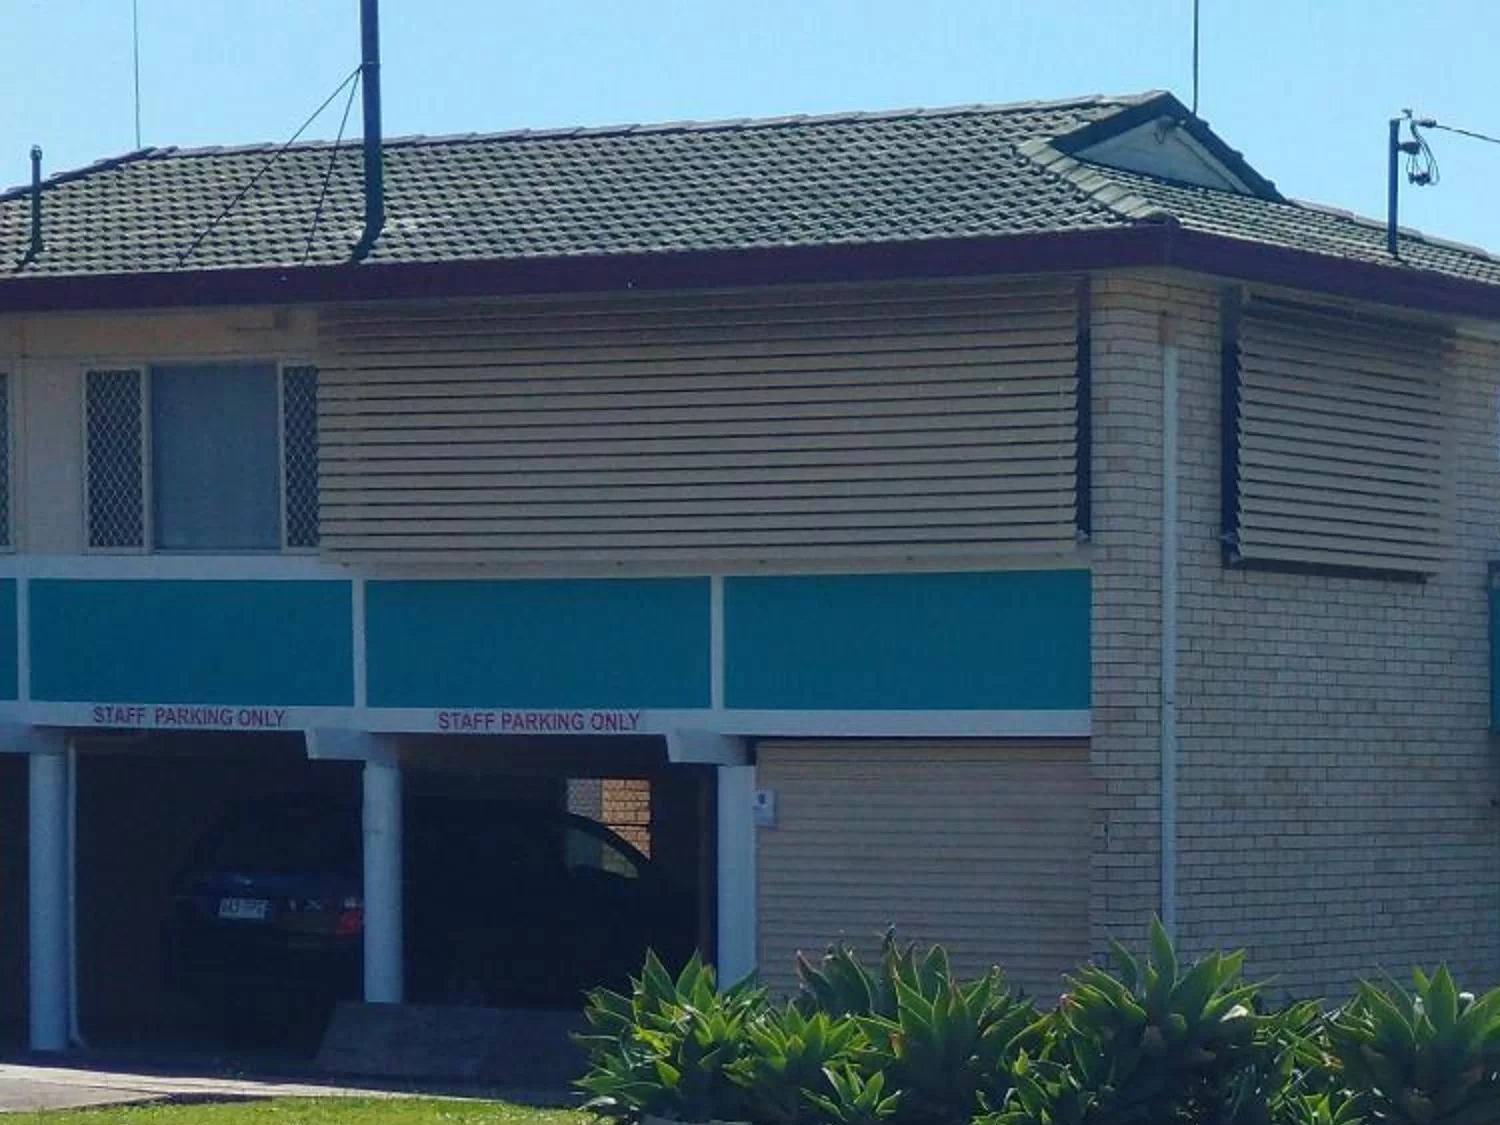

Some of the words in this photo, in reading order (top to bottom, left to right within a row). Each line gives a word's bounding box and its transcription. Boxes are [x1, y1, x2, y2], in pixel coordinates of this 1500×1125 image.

[93, 706, 148, 724] STAFF
[155, 707, 233, 726] PARKING
[238, 709, 286, 727] ONLY
[438, 711, 494, 730] STAFF
[501, 712, 585, 731] PARKING
[591, 712, 641, 731] ONLY
